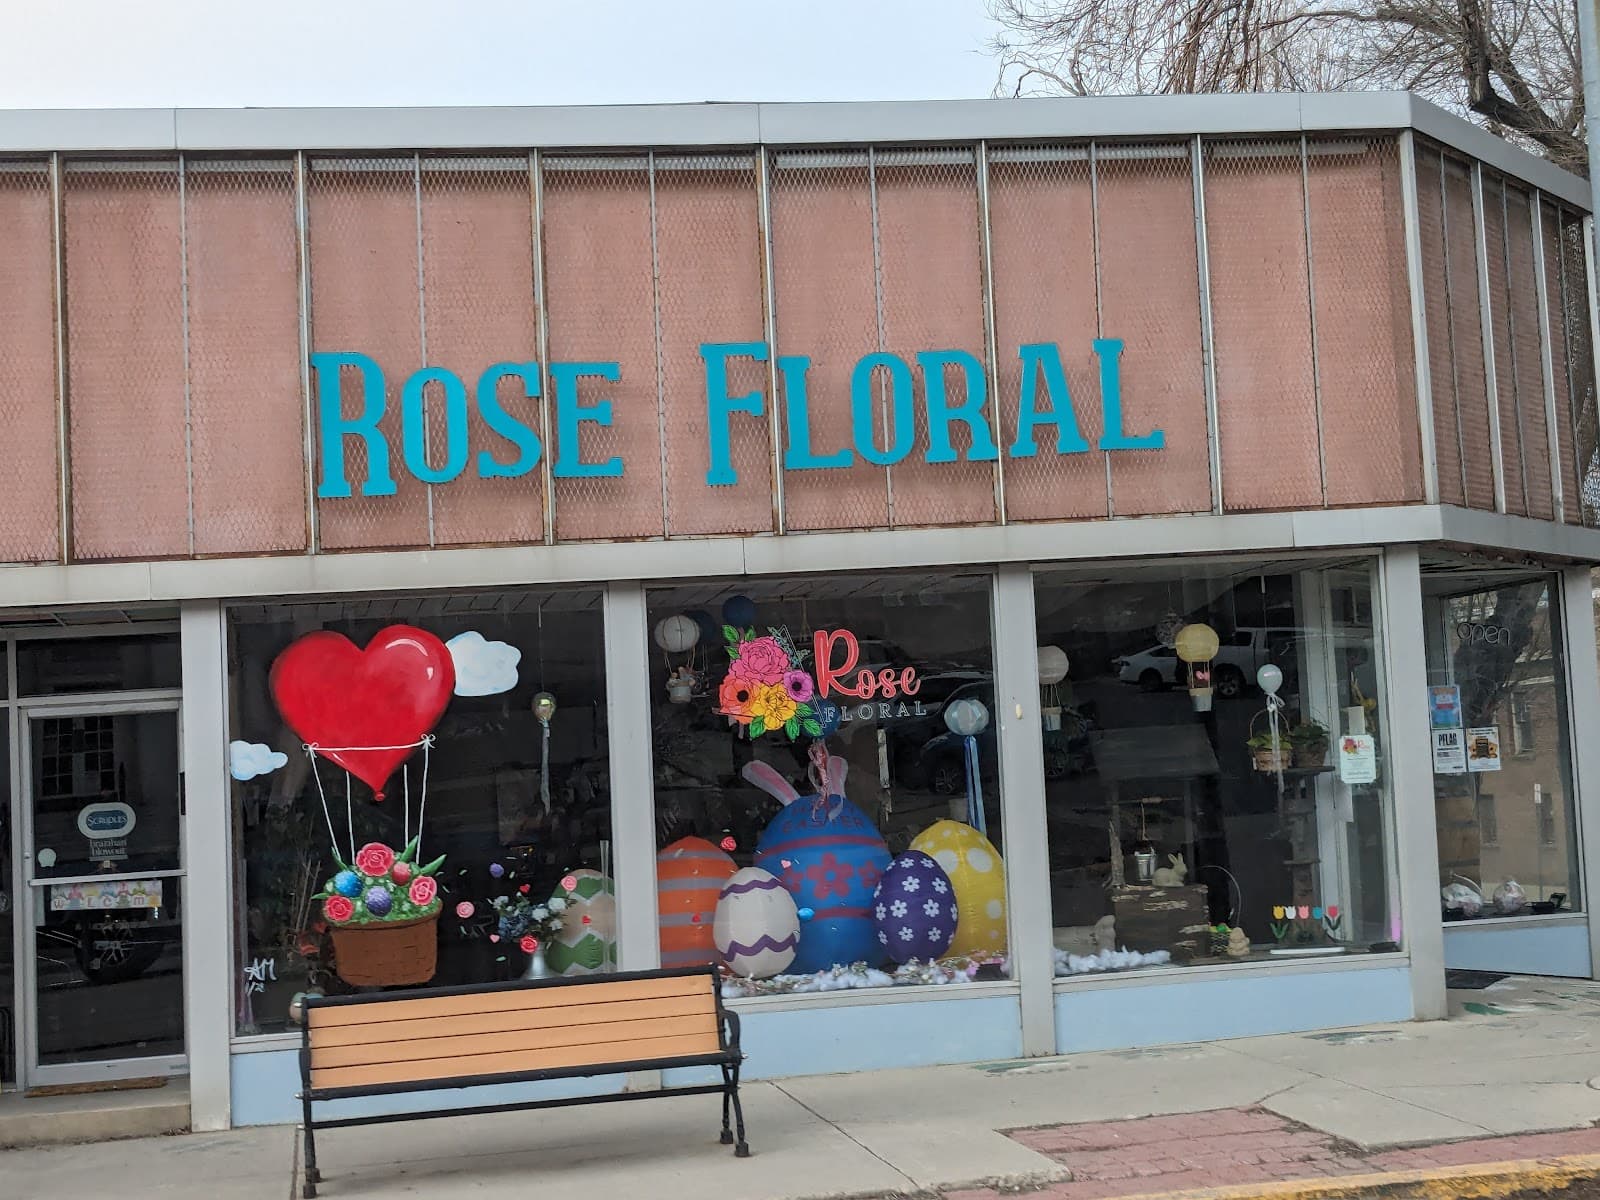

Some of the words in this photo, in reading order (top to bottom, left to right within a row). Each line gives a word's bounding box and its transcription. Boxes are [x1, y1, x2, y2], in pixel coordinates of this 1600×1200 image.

[310, 351, 625, 498] ROSE
[700, 338, 1165, 487] FLORAL
[814, 629, 921, 699] Rose
[823, 700, 927, 723] FLORAL
